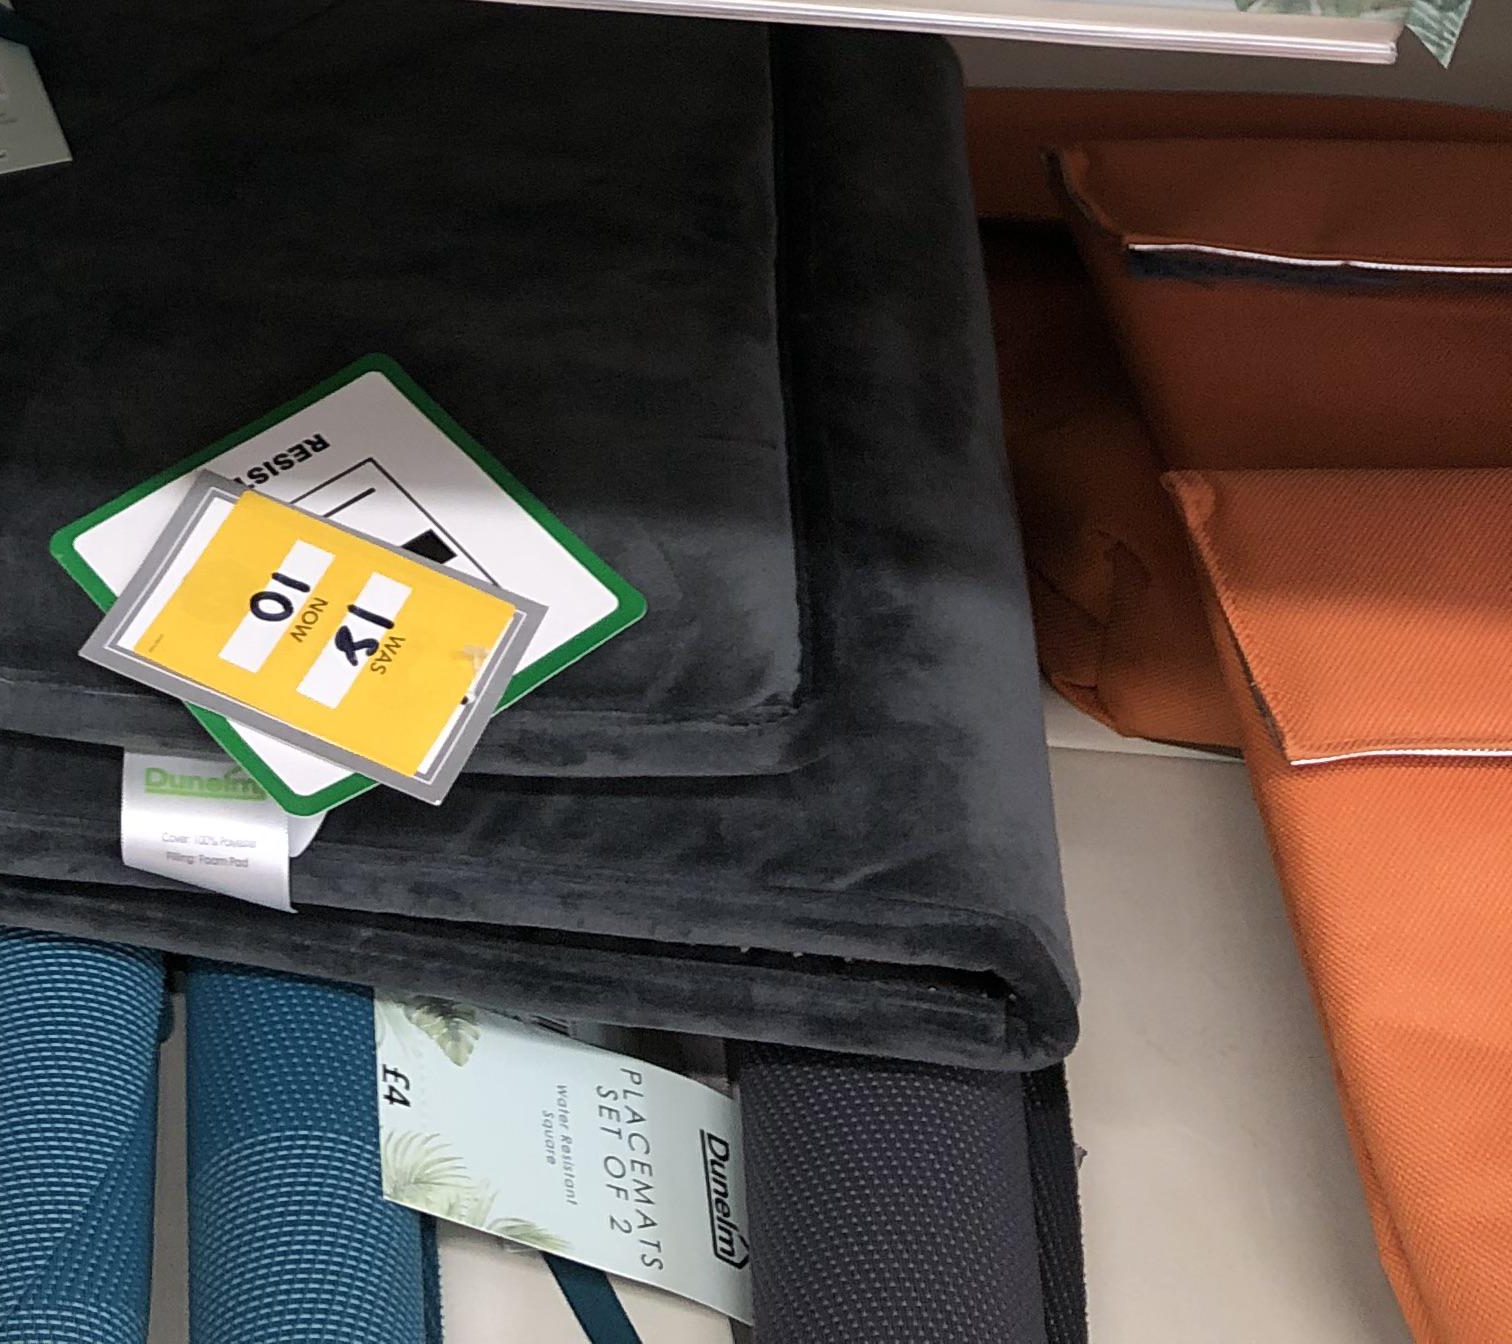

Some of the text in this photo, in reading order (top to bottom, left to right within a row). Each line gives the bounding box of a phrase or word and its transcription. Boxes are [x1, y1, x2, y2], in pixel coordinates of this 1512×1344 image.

[249, 571, 311, 623] 10
[289, 597, 329, 644] NOW
[370, 635, 407, 676] WAS
[382, 1063, 411, 1108] £4
[541, 1109, 557, 1166] Square
[556, 1083, 578, 1206] Water Resistant
[596, 1085, 633, 1236] SET OF 2
[620, 1067, 664, 1271] PLACEMATS
[702, 1130, 745, 1262] Dunelm
